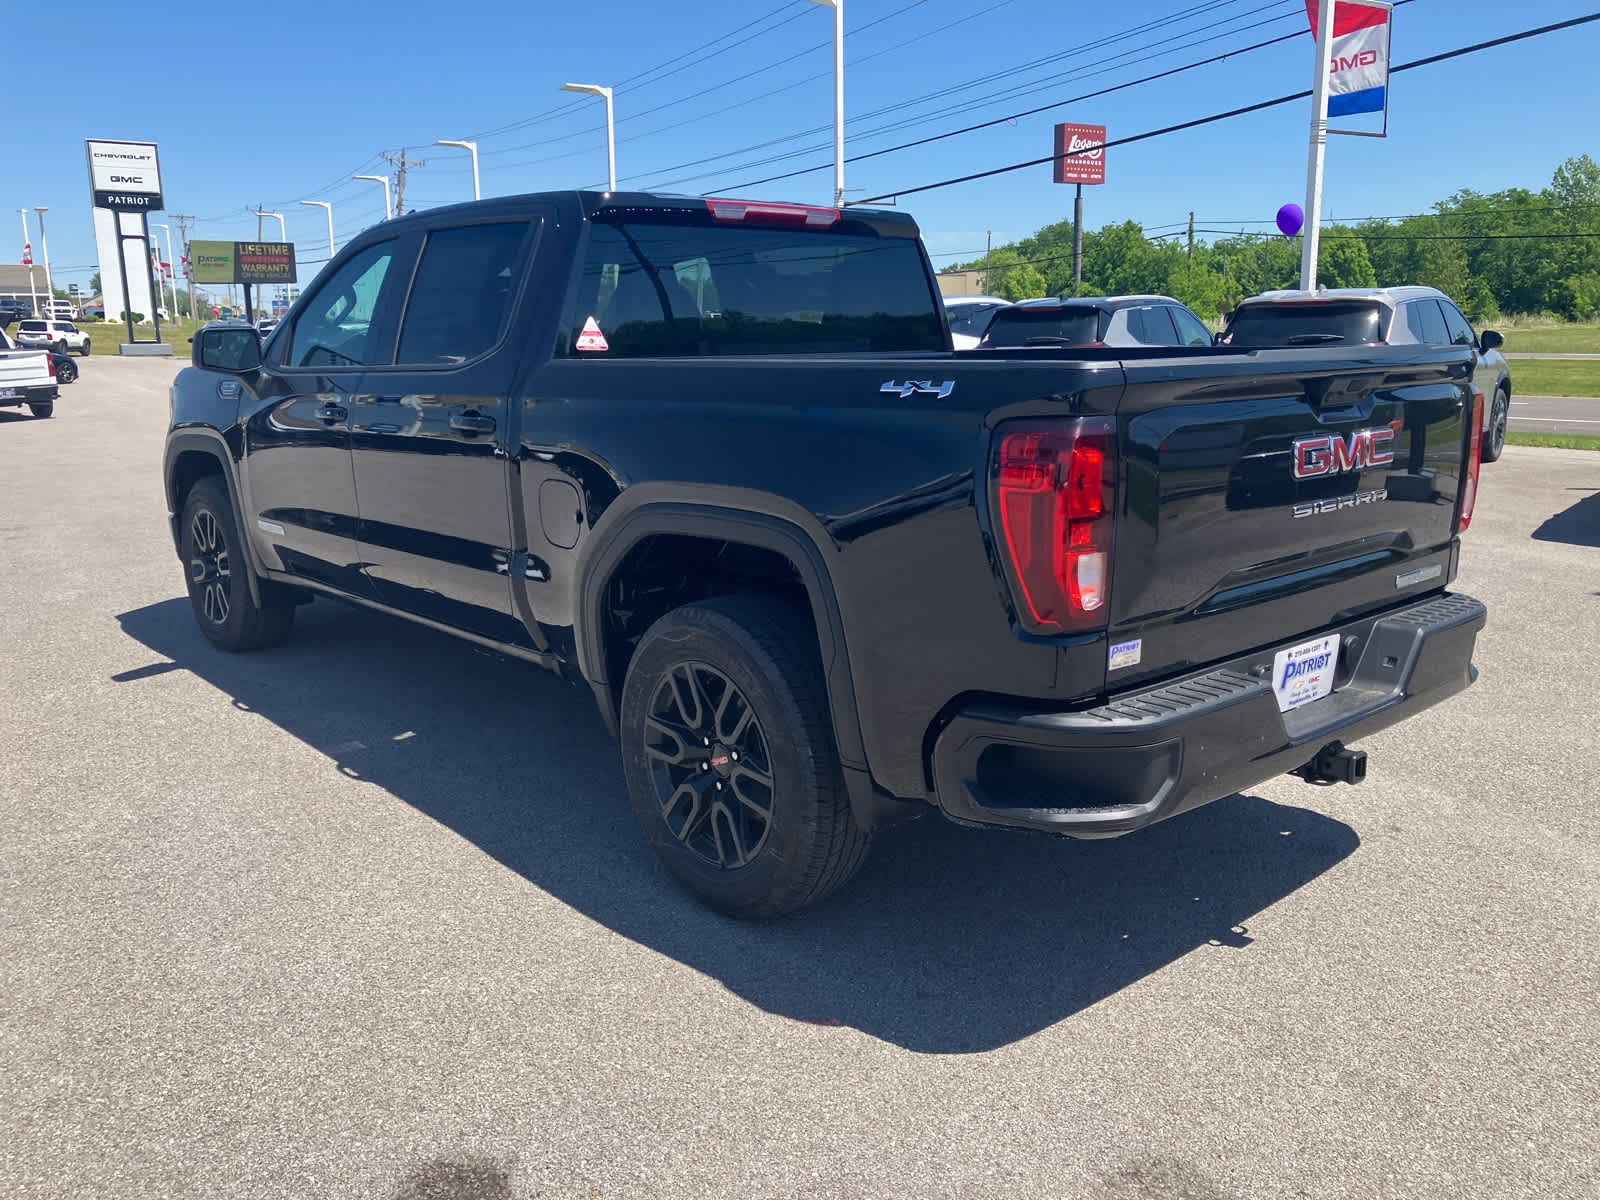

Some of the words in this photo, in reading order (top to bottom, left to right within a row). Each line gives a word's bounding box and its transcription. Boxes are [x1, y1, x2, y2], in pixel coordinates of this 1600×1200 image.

[93, 153, 152, 161] CHEVROLET
[110, 175, 143, 184] GMC
[107, 195, 150, 206] PATRIOT
[239, 244, 289, 256] LIFETIME
[240, 263, 290, 273] WARRANTY
[1293, 427, 1395, 480] GMC
[1292, 488, 1389, 519] SIERRA
[1110, 642, 1139, 659] PATRIOT
[1280, 651, 1332, 691] PATRIOT
